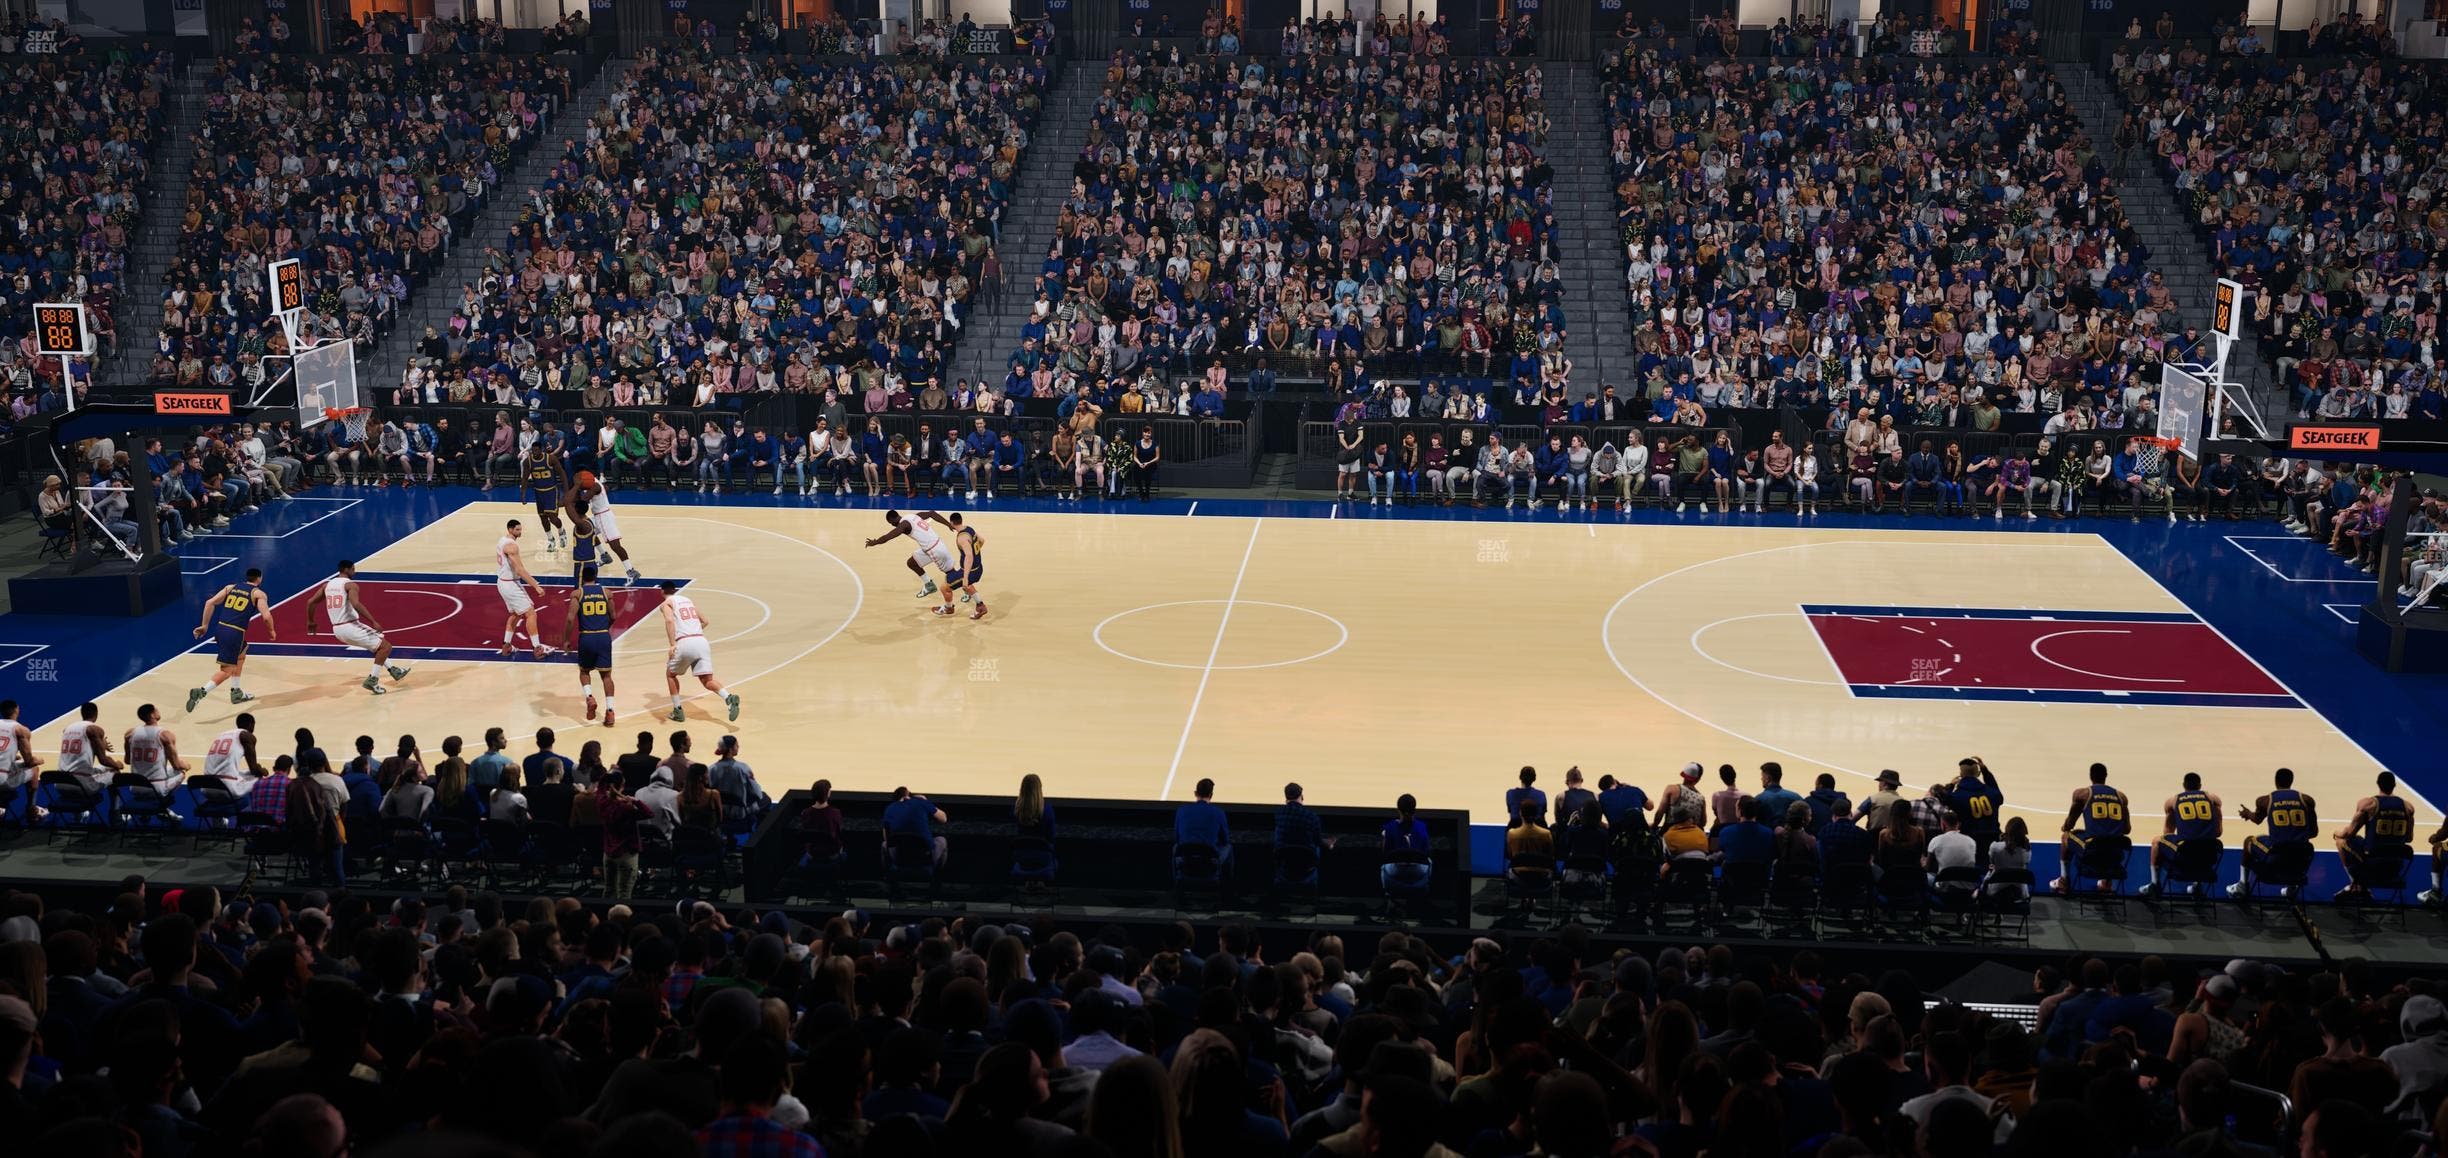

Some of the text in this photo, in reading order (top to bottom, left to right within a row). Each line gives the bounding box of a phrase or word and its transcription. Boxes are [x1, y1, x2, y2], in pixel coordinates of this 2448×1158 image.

[48, 326, 73, 348] 88
[162, 397, 223, 410] SEATGEEK
[2301, 431, 2369, 446] SEATGEEK
[225, 594, 249, 611] 00
[583, 601, 606, 615] 00
[1970, 796, 1993, 818] 00
[2092, 802, 2123, 820] 00
[2178, 801, 2211, 820] 00
[2272, 809, 2306, 826] 00
[2375, 819, 2407, 836] 00
